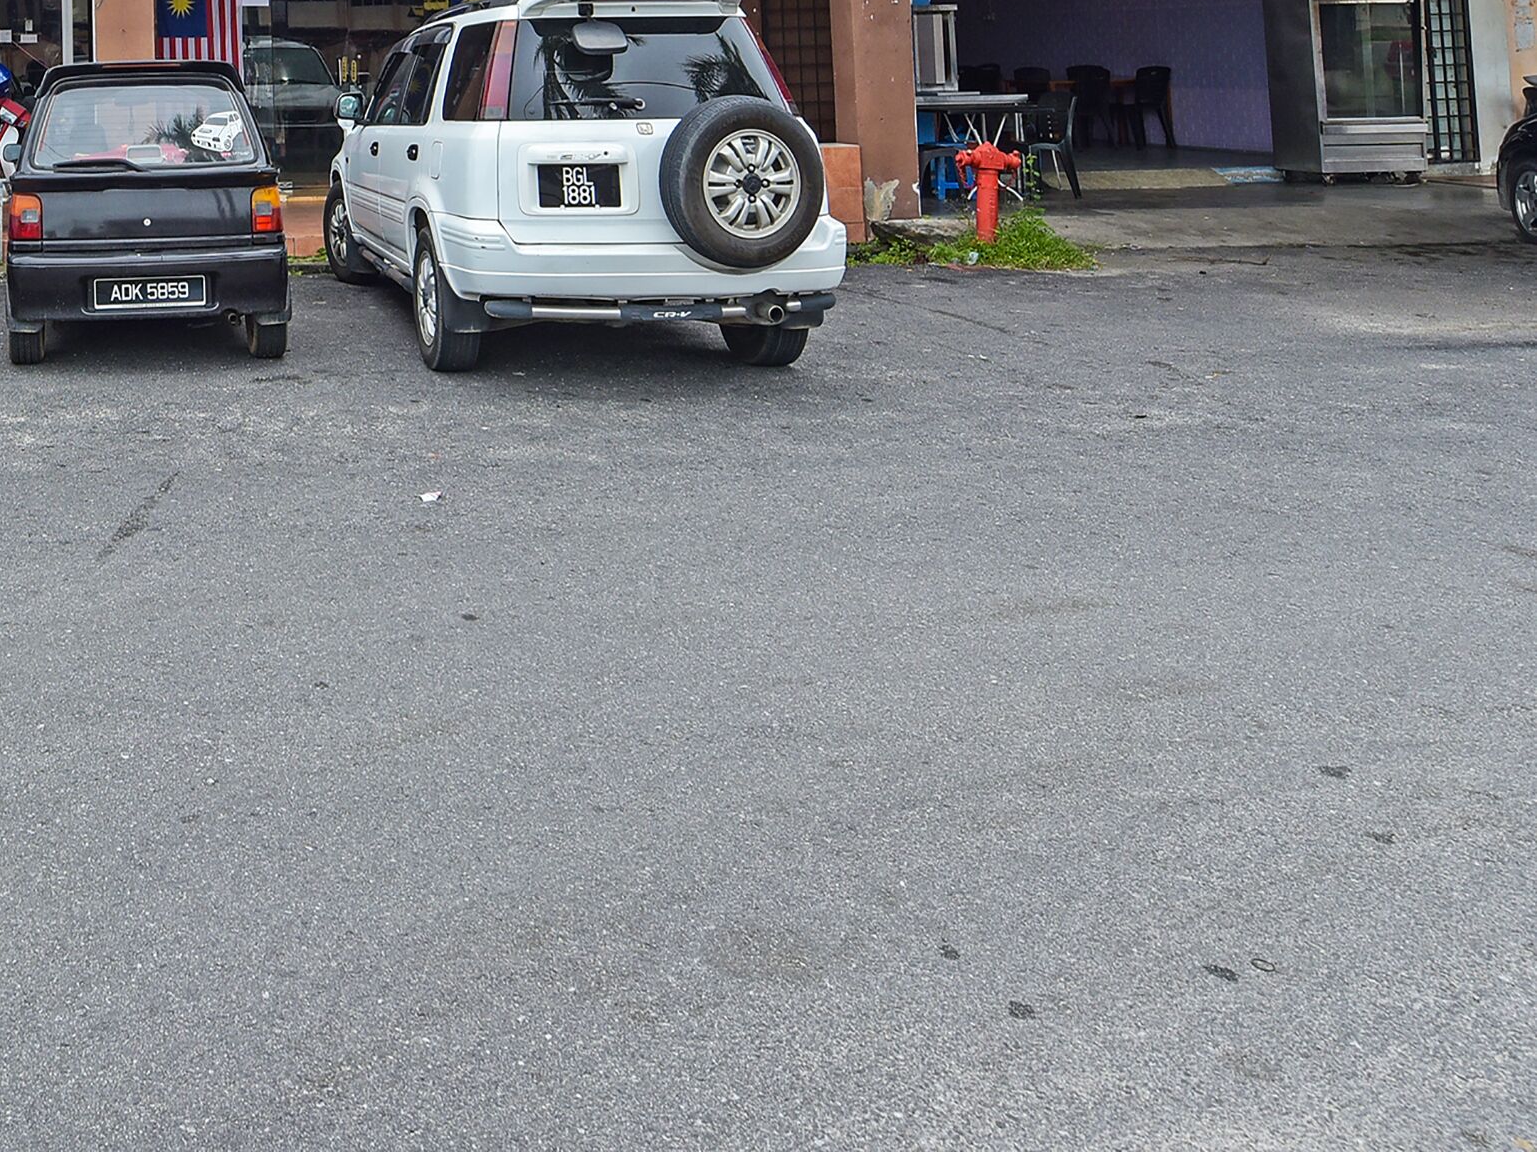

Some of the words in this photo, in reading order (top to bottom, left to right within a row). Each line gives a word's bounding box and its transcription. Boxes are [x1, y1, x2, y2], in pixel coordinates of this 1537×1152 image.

[562, 166, 594, 186] BGL
[562, 185, 596, 205] 1881
[146, 281, 189, 300] 5859
